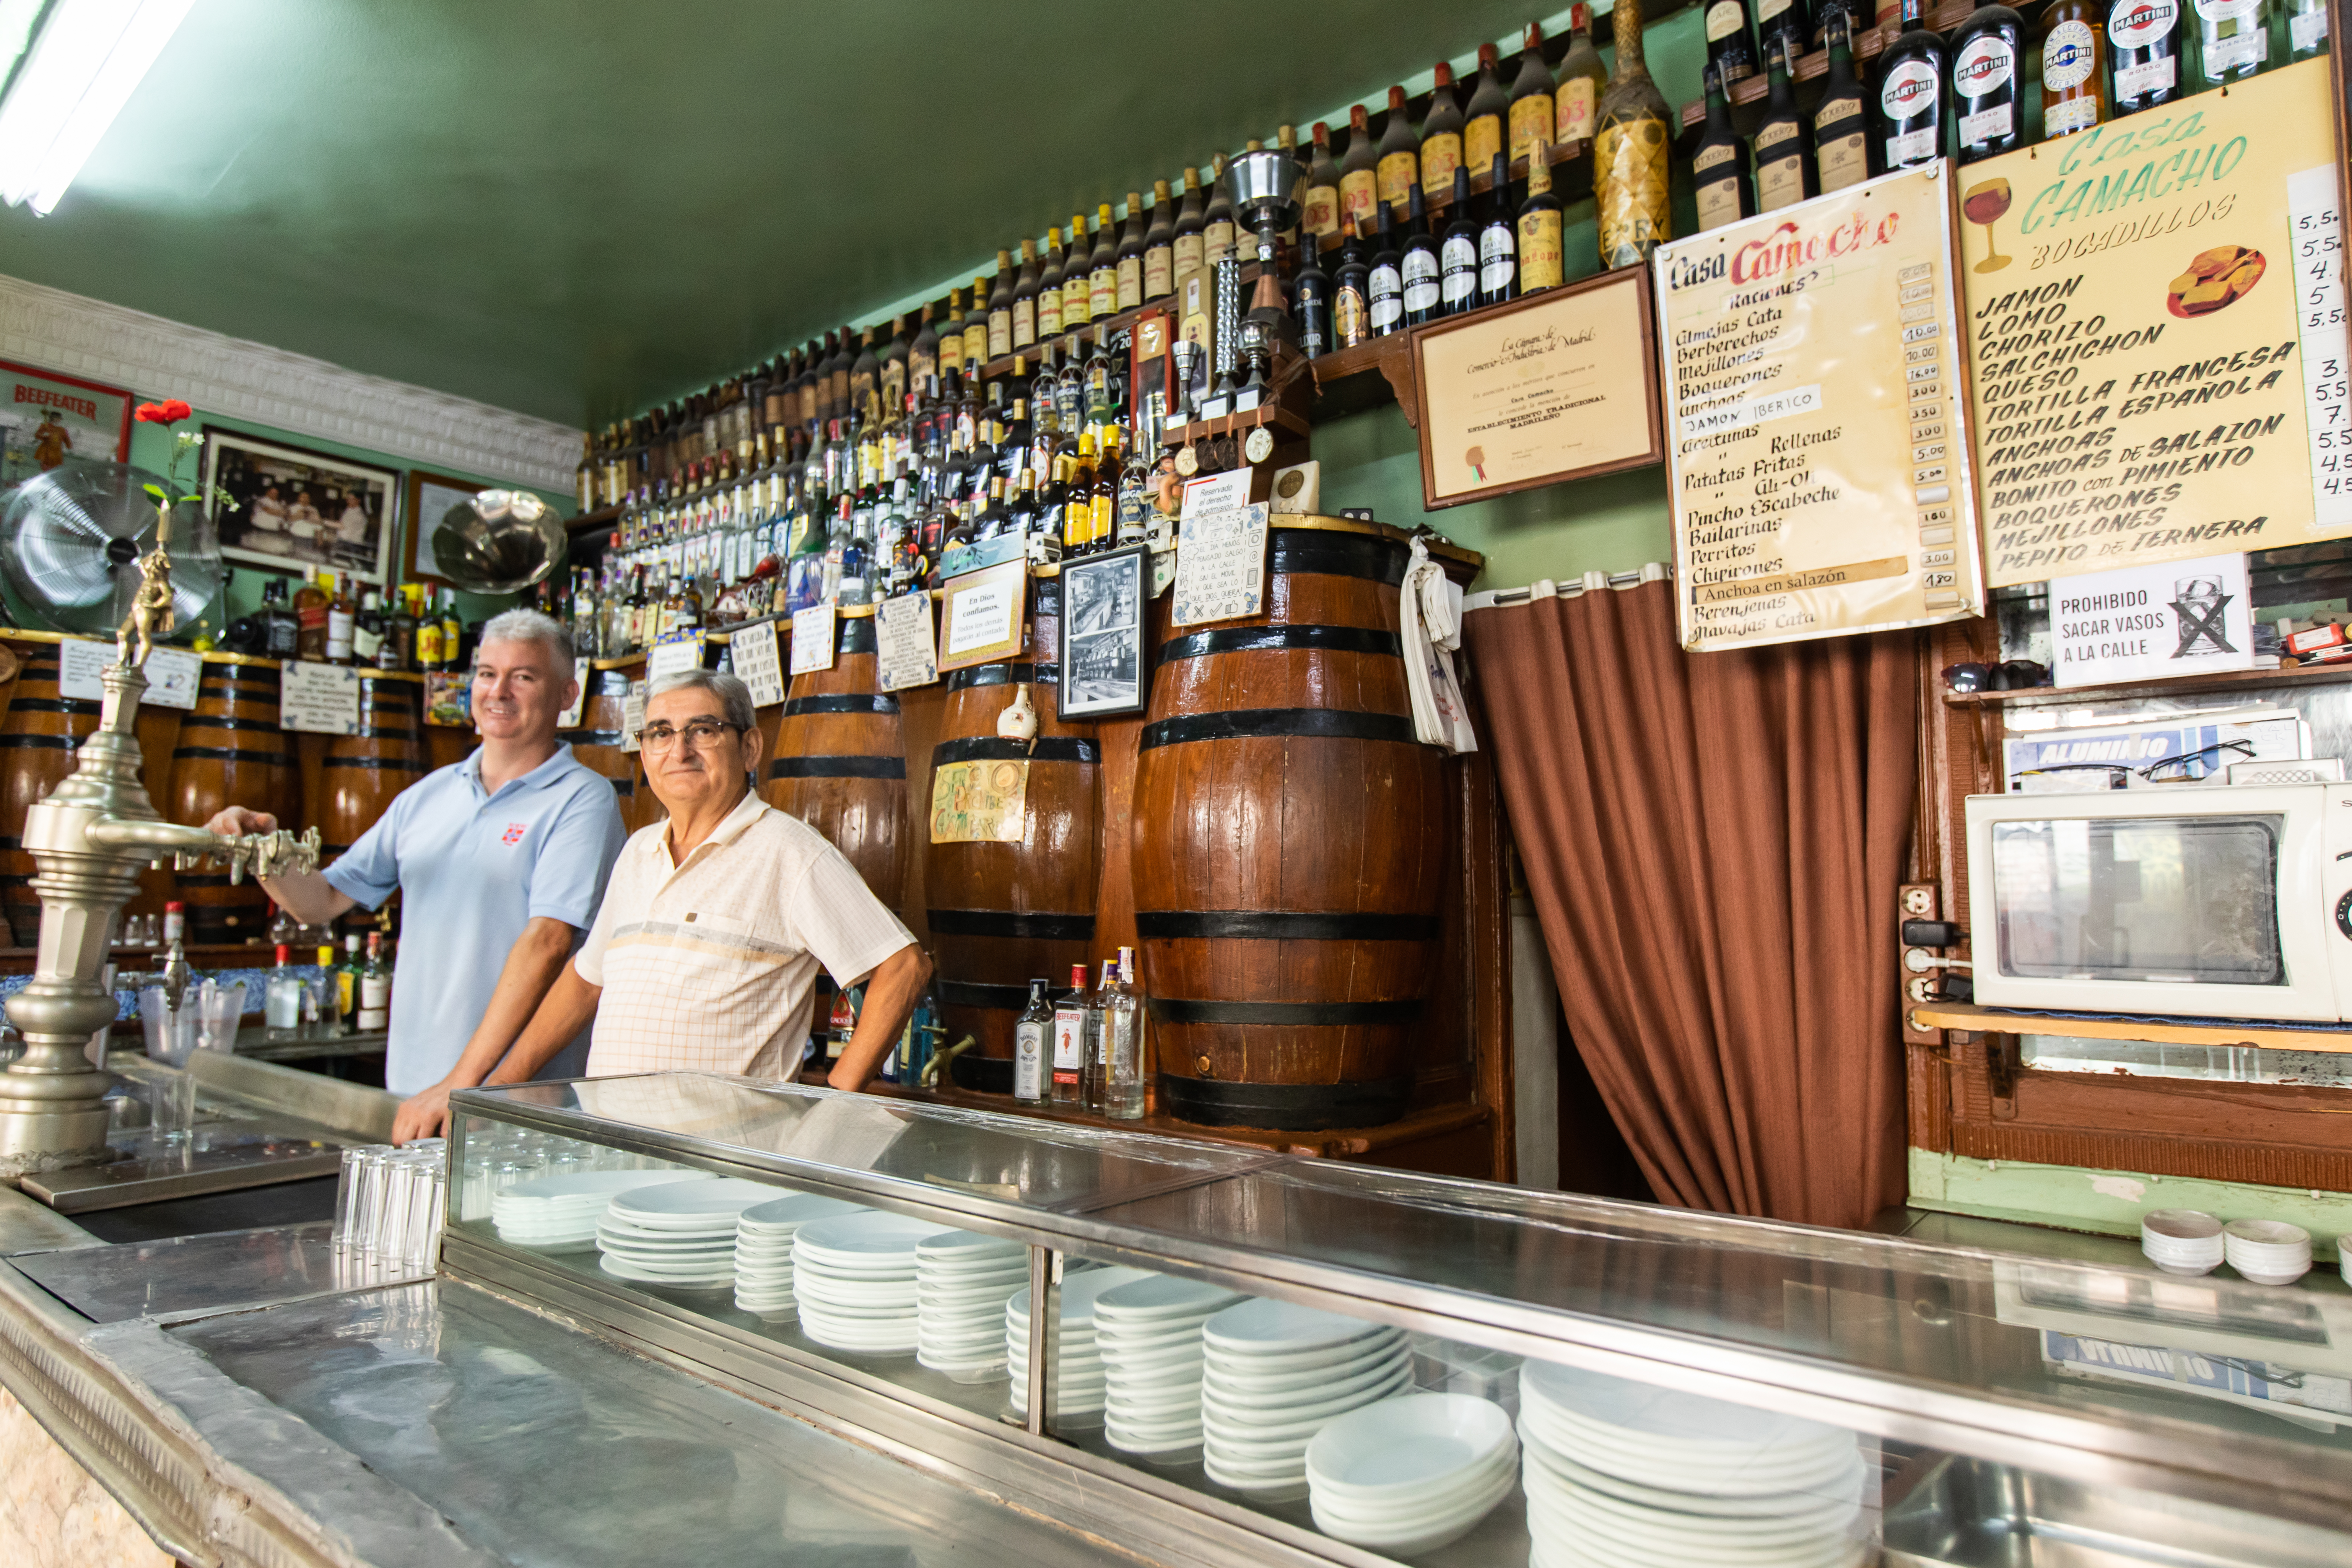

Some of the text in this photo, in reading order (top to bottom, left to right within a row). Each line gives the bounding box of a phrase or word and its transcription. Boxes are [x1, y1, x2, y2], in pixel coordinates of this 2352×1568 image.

[2115, 7, 2170, 32] MARTINI
[2215, 36, 2254, 50] BIANCO
[1959, 57, 2007, 80] MARTINI
[2046, 47, 2090, 69] MARTINI
[2129, 64, 2160, 76] ROSSO
[1886, 80, 1931, 104] MARTINI
[1970, 111, 1998, 124] ROSSO
[1897, 134, 1923, 143] ROSSO
[2058, 111, 2206, 176] Casa
[2020, 136, 2247, 234] CAMACHO
[2030, 194, 2237, 270] BOCADILLOS
[1408, 278, 1428, 287] FINO
[1671, 253, 1726, 291] Casa
[1975, 275, 2084, 319] JAMON
[1676, 318, 1739, 346] Almejas
[1906, 326, 1937, 340] 10.00
[1978, 303, 2066, 341] LOMO
[1557, 326, 1596, 348] Madrid
[1677, 325, 1779, 364] Berberechos
[1978, 316, 2105, 361] CHORIZO
[1679, 347, 1764, 381] Mejillones
[1906, 347, 1935, 361] 10.00
[1980, 323, 2166, 382] SALCHICHON
[1679, 364, 1783, 401] Boquerones
[1908, 367, 1936, 380] 16.00
[1983, 366, 2079, 404] QUESO
[1986, 342, 2297, 424] TORTILLA FRANCESA
[14, 384, 97, 421] BEEFEATER
[1912, 385, 1936, 398] 300
[1467, 395, 1606, 433] ESTABLECIMIENTO TRADICIONAL
[1686, 394, 1812, 431] JAMON IBERICO
[1912, 407, 1936, 419] 350
[1984, 369, 2284, 446] TORTILLA ESPAÑOLA
[1510, 412, 1561, 429] MADRILEÑO
[1916, 426, 1940, 439] 300
[1682, 424, 1760, 454] Aceitunas
[1771, 426, 1841, 455] Rellenas
[1986, 427, 2116, 467] ANCHOAS
[1988, 413, 2285, 488] ANCHOAS DE SALAZON
[1918, 446, 1945, 460] 5.00
[1685, 454, 1805, 491] Patatas Fritas
[1755, 470, 1815, 496] Ali-Oli
[1990, 446, 2254, 509] BONITO con PIMIENTO
[1200, 484, 1233, 497] Reservado
[1206, 494, 1232, 506] derecho
[1195, 502, 1233, 517] de admisión
[1688, 486, 1840, 529] Pincho Escabeche
[1993, 483, 2183, 530] BOQUERONES
[1690, 517, 1783, 547] Bailarinas
[1994, 506, 2168, 551] MEJILLONES
[1196, 548, 1243, 563] PENSADO SALGO
[1222, 539, 1240, 547] MENOS
[1691, 543, 1756, 566] Perritos
[1997, 516, 2268, 572] PEPITO DE TERNERA
[1219, 560, 1235, 568] CALLE
[1692, 558, 1783, 584] Chipirones
[1925, 554, 1949, 564] 3.00
[980, 593, 995, 602] Dios
[1704, 569, 1846, 602] Anchoa en salazón
[963, 604, 999, 618] confiamos.
[1694, 595, 1787, 623] Berenjenas
[2061, 590, 2147, 615] PROHIBIDO
[958, 625, 973, 633] Todos
[984, 617, 1003, 626] demás
[2062, 613, 2165, 639] SACAR VASOS
[953, 633, 974, 645] pagarán
[2064, 639, 2148, 663] A LA CALLE
[2224, 723, 2293, 735] ROYAL
[1056, 1013, 1080, 1023] BEEFEATER
[1020, 1034, 1039, 1042] BOMBAY
